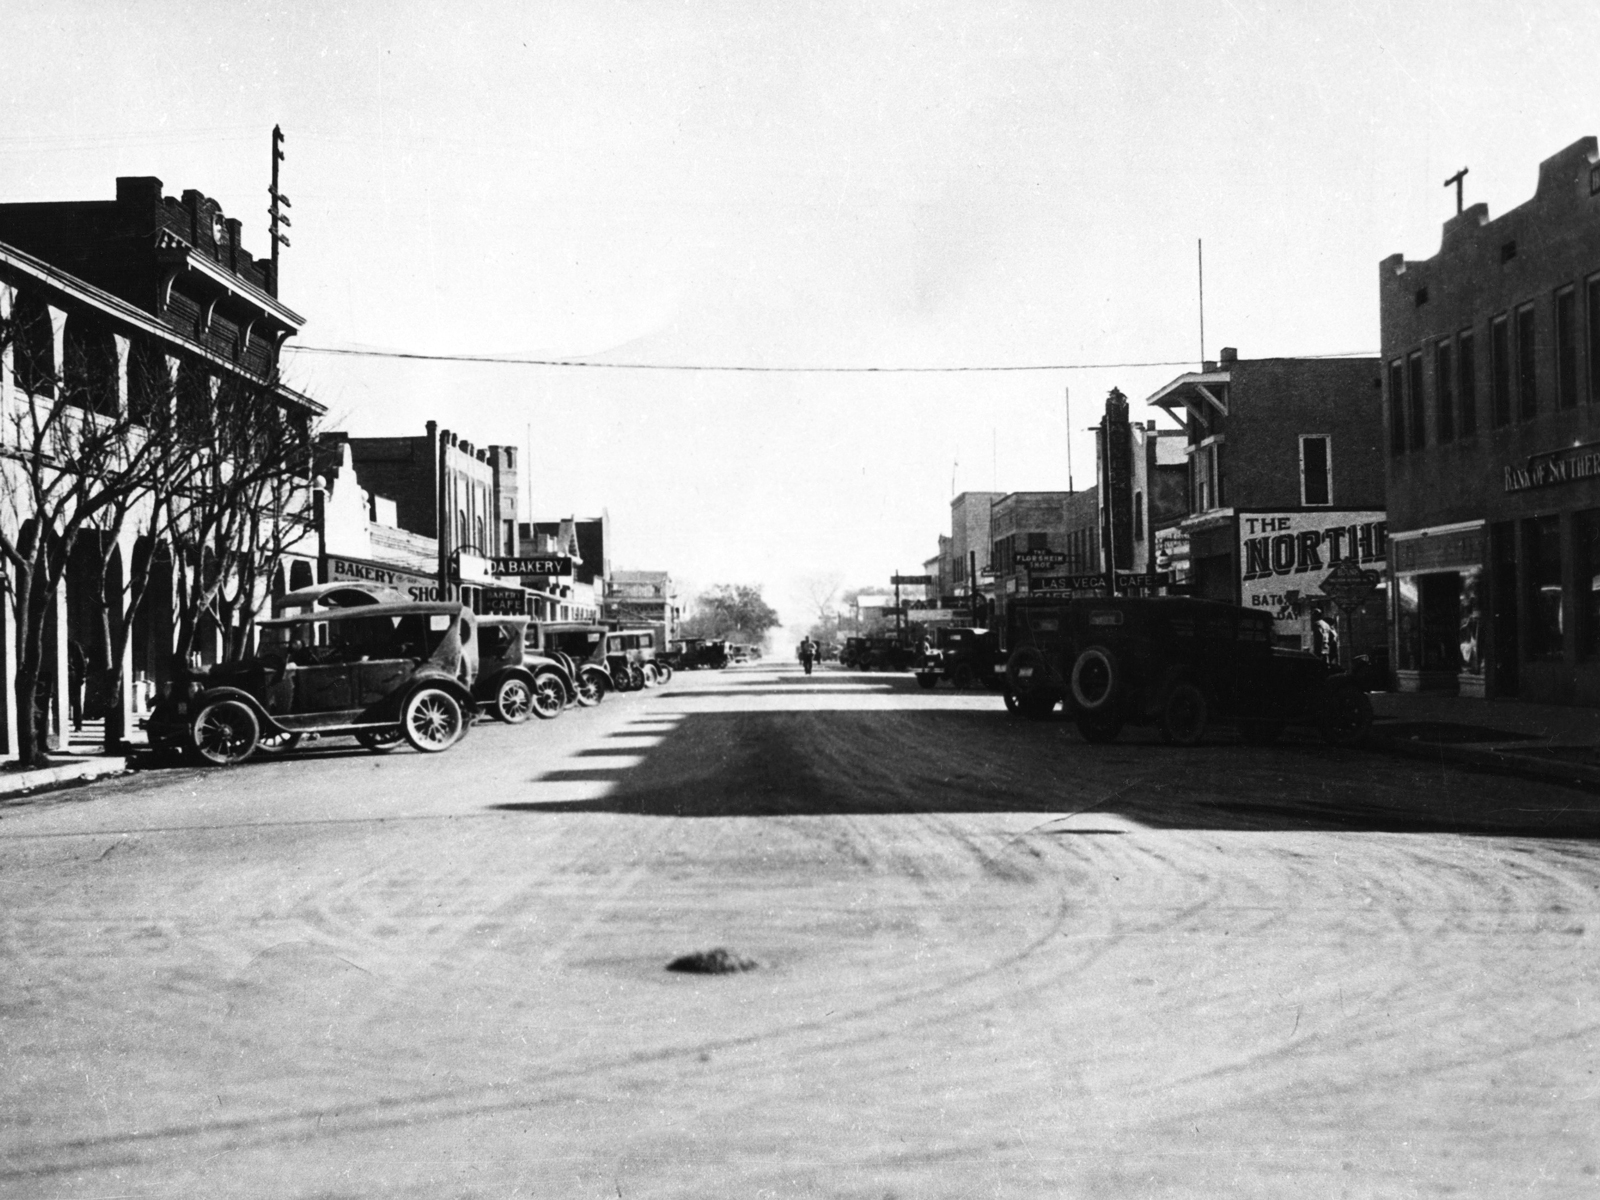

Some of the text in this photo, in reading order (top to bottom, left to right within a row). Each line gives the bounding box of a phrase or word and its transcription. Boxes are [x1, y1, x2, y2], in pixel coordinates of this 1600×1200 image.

[1245, 517, 1291, 534] THE
[334, 560, 396, 585] BAKERY
[508, 560, 563, 574] BAKERY
[1041, 574, 1153, 589] LAS VEGA CAFE
[407, 586, 440, 603] SHO
